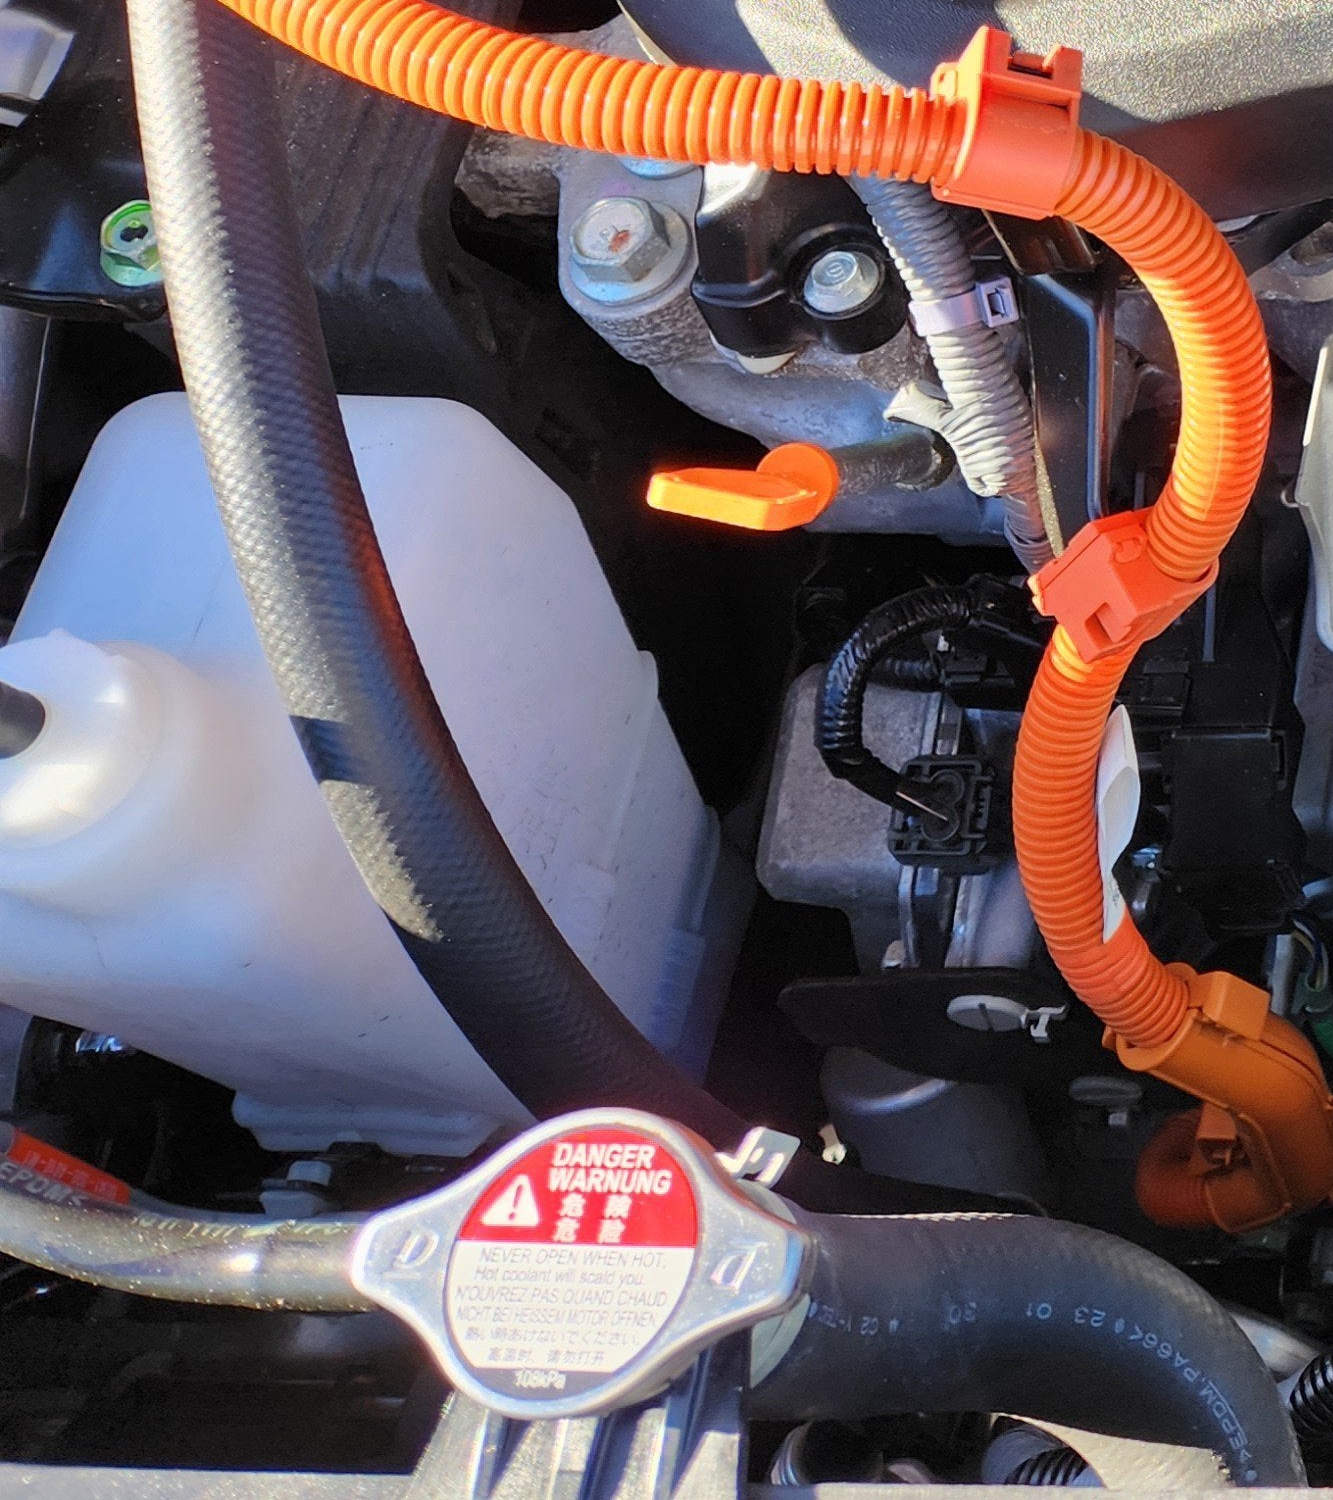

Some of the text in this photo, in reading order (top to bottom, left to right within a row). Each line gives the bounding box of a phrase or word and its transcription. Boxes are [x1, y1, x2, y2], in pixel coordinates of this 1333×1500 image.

[551, 1142, 656, 1169] DANGER
[548, 1167, 673, 1194] WARNUNG
[479, 1247, 531, 1264] NEVER
[536, 1249, 579, 1265] OPEN
[583, 1250, 630, 1267] WHEN
[474, 1266, 499, 1281] Hot
[502, 1268, 552, 1282] coolant
[555, 1268, 577, 1283] will
[580, 1270, 616, 1285] scald
[455, 1285, 529, 1303] N'OUVREZ
[531, 1287, 559, 1304] PAS
[562, 1288, 614, 1306] QUAND
[456, 1305, 492, 1322] NICHT
[492, 1307, 510, 1323] BEI
[567, 1309, 609, 1325] MOTOR
[1073, 1306, 1107, 1329] 23
